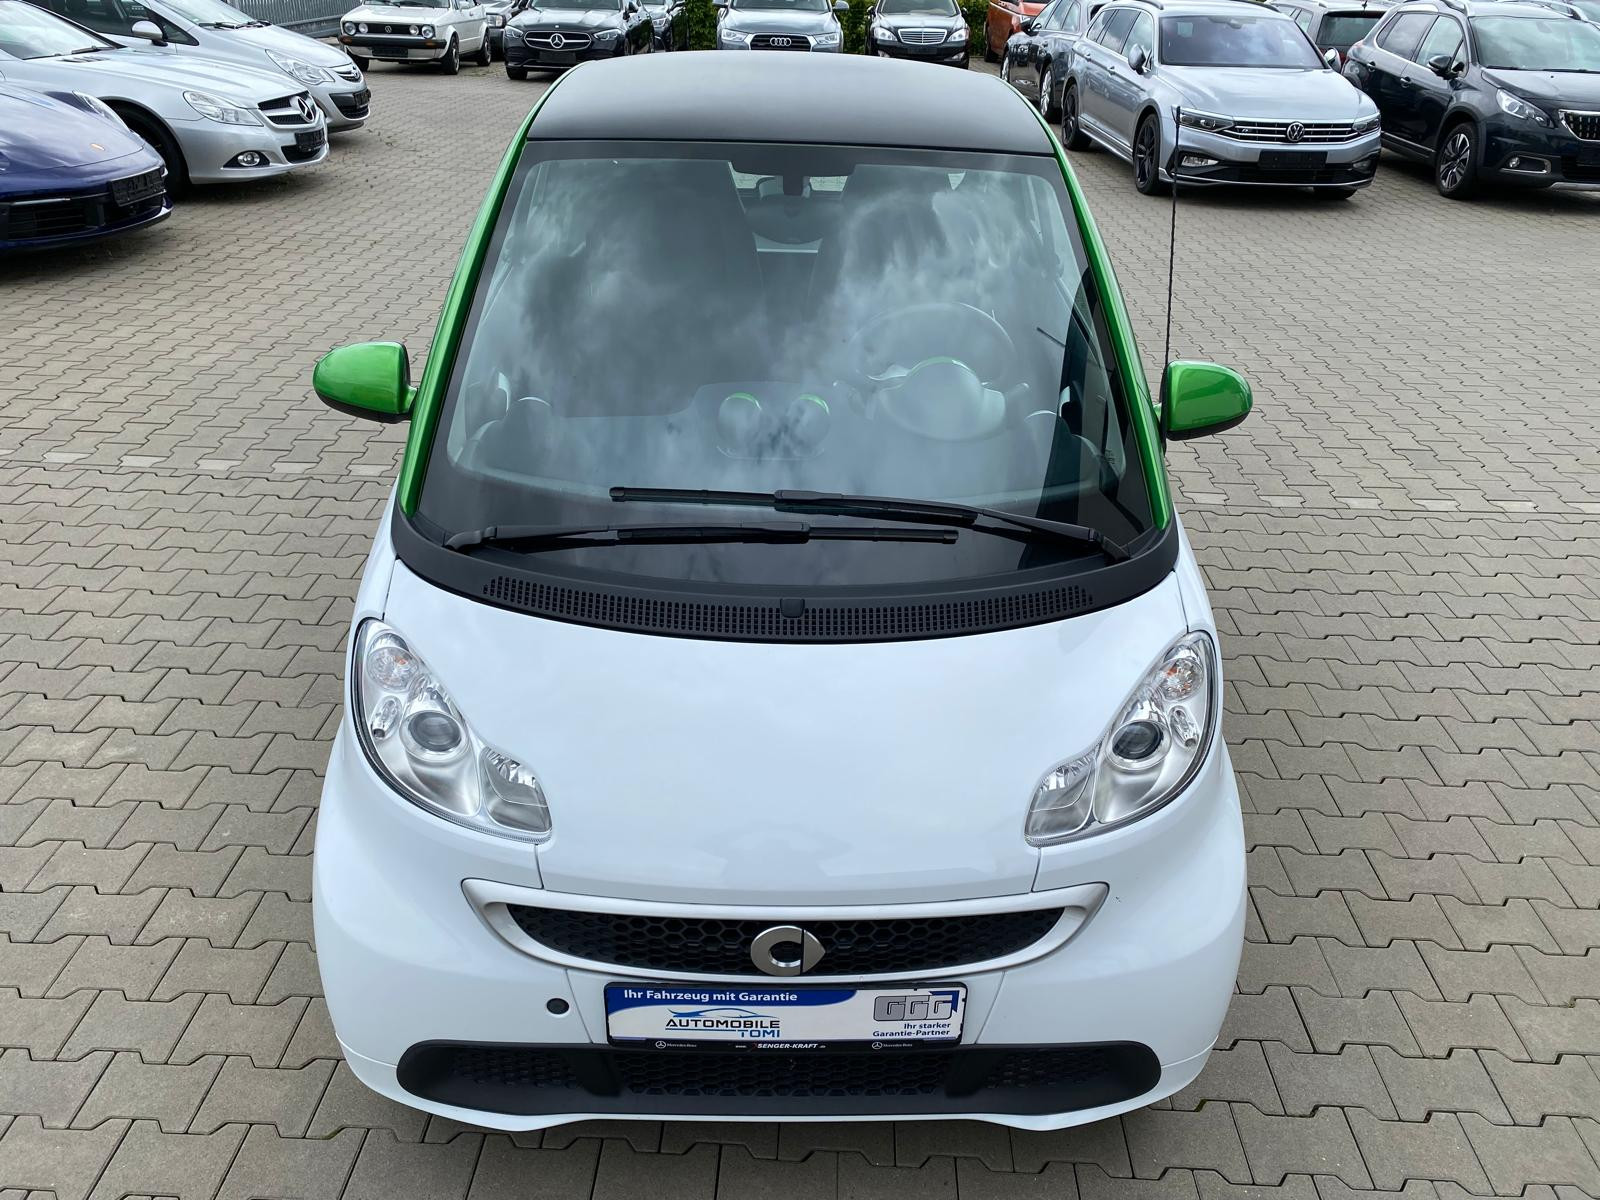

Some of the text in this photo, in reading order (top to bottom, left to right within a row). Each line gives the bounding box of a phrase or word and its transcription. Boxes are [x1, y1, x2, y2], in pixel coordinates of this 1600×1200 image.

[624, 989, 798, 1002] Ihr Fahrzeug mit Garantie
[665, 1019, 780, 1029] AUTOMOBILE
[736, 1029, 780, 1038] TOMI
[872, 1029, 951, 1037] Garantie-Partner
